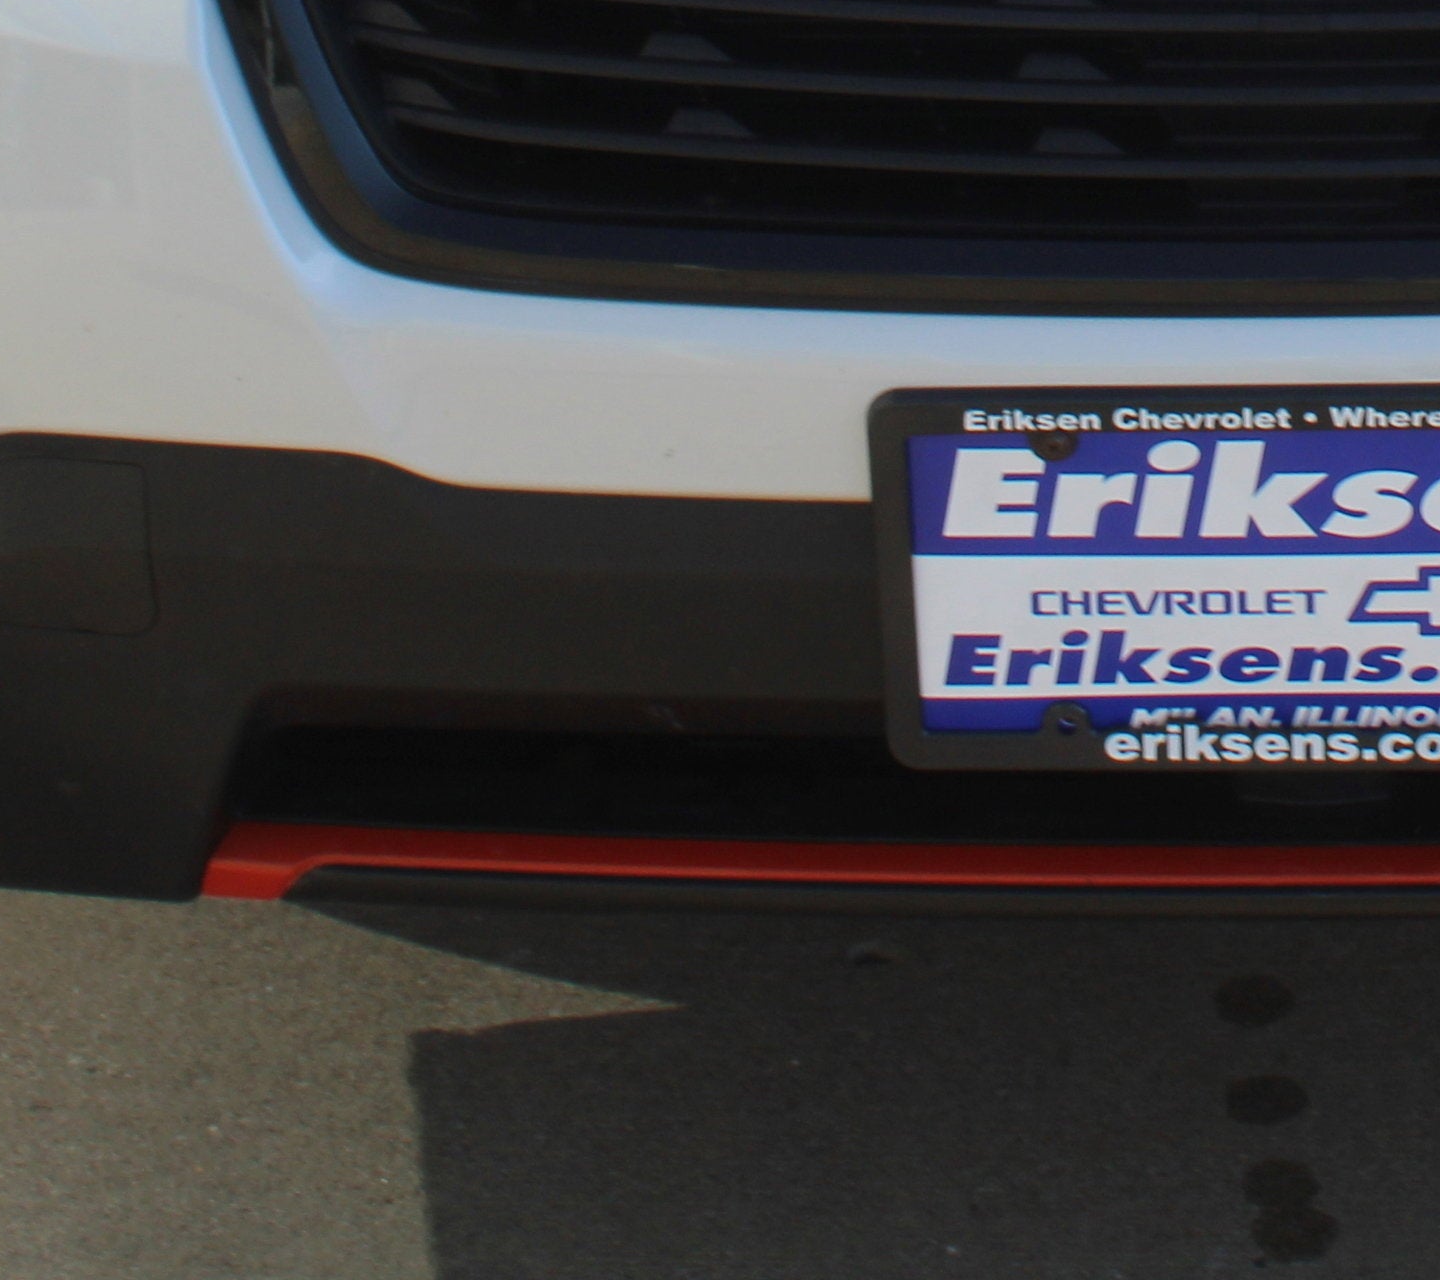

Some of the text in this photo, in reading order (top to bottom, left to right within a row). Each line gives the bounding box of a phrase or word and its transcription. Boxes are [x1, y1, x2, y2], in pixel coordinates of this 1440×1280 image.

[963, 408, 1102, 432] Eriksen
[1112, 407, 1293, 431] Chevrolet
[1030, 590, 1327, 617] CHEVROLET
